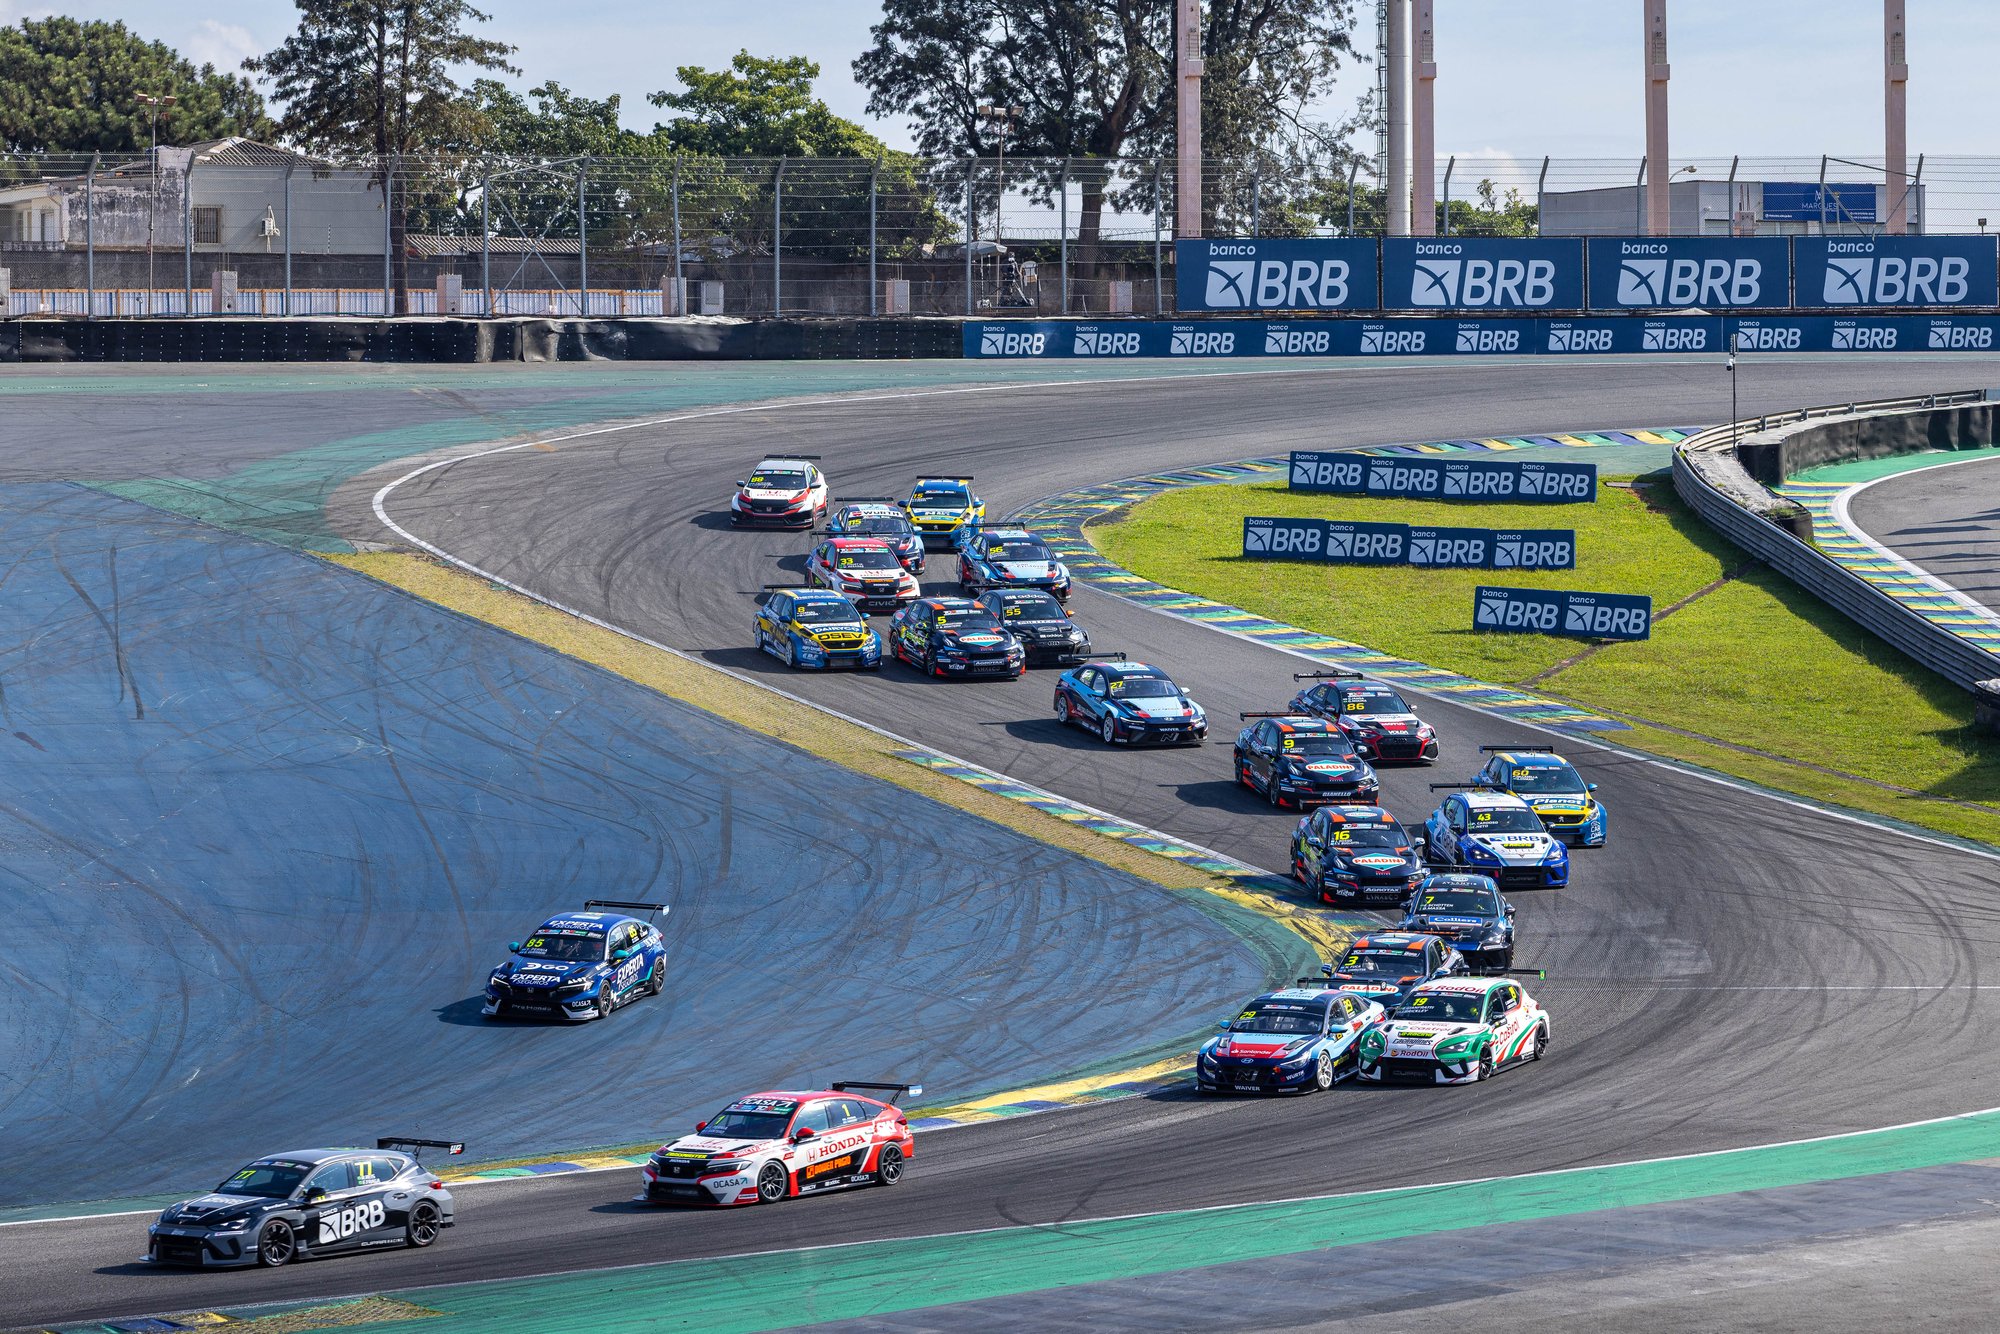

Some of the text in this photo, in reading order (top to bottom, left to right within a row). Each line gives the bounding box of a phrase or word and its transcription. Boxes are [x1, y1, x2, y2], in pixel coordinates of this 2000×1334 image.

[1210, 243, 1255, 255] banco
[1416, 242, 1461, 254] banco
[1622, 242, 1667, 253] banco
[1828, 241, 1874, 252] banco
[1257, 260, 1349, 306] BRB
[1462, 260, 1555, 305] BRB
[1669, 259, 1761, 304] BRB
[1875, 257, 1969, 302] BRB
[1005, 333, 1045, 354] BRB
[1098, 333, 1140, 354] BRB
[1192, 333, 1234, 353] BRB
[1286, 332, 1329, 352] BRB
[1382, 331, 1425, 352] BRB
[1478, 331, 1519, 351] BRB
[1570, 330, 1612, 350] BRB
[1664, 329, 1706, 349] BRB
[1758, 328, 1801, 348] BRB
[1854, 328, 1897, 348] BRB
[1950, 327, 1992, 347] BRB
[1315, 462, 1362, 485] BRB
[1392, 468, 1438, 491] BRB
[1467, 472, 1514, 494] BRB
[1543, 473, 1589, 496] BRB
[1249, 517, 1274, 525] banco
[1271, 528, 1320, 552] BRB
[1353, 534, 1402, 557] BRB
[1434, 540, 1484, 563] BRB
[1520, 542, 1570, 565] BRB
[1570, 596, 1595, 606] banco
[938, 616, 946, 624] 5
[1006, 608, 1021, 616] 55
[1505, 601, 1558, 629] BRB
[1593, 607, 1646, 633] BRB
[1284, 740, 1294, 748] 9
[1334, 831, 1350, 840] 16
[1425, 896, 1435, 904] 7
[549, 920, 603, 929] EXPERTA
[526, 939, 544, 948] 85
[617, 953, 644, 984] EXPERTA
[1345, 956, 1358, 966] 3
[510, 974, 560, 982] EXPERTA
[1413, 997, 1428, 1006] 19
[1240, 1011, 1256, 1019] 29
[1500, 1018, 1520, 1044] Castrol
[716, 1115, 726, 1124] 1
[842, 1104, 850, 1116] 1
[819, 1134, 865, 1157] HONDA
[235, 1170, 256, 1180] 77
[355, 1162, 372, 1176] 77
[714, 1179, 740, 1188] OCASA
[319, 1208, 338, 1217] banco
[341, 1200, 386, 1237] BRB
